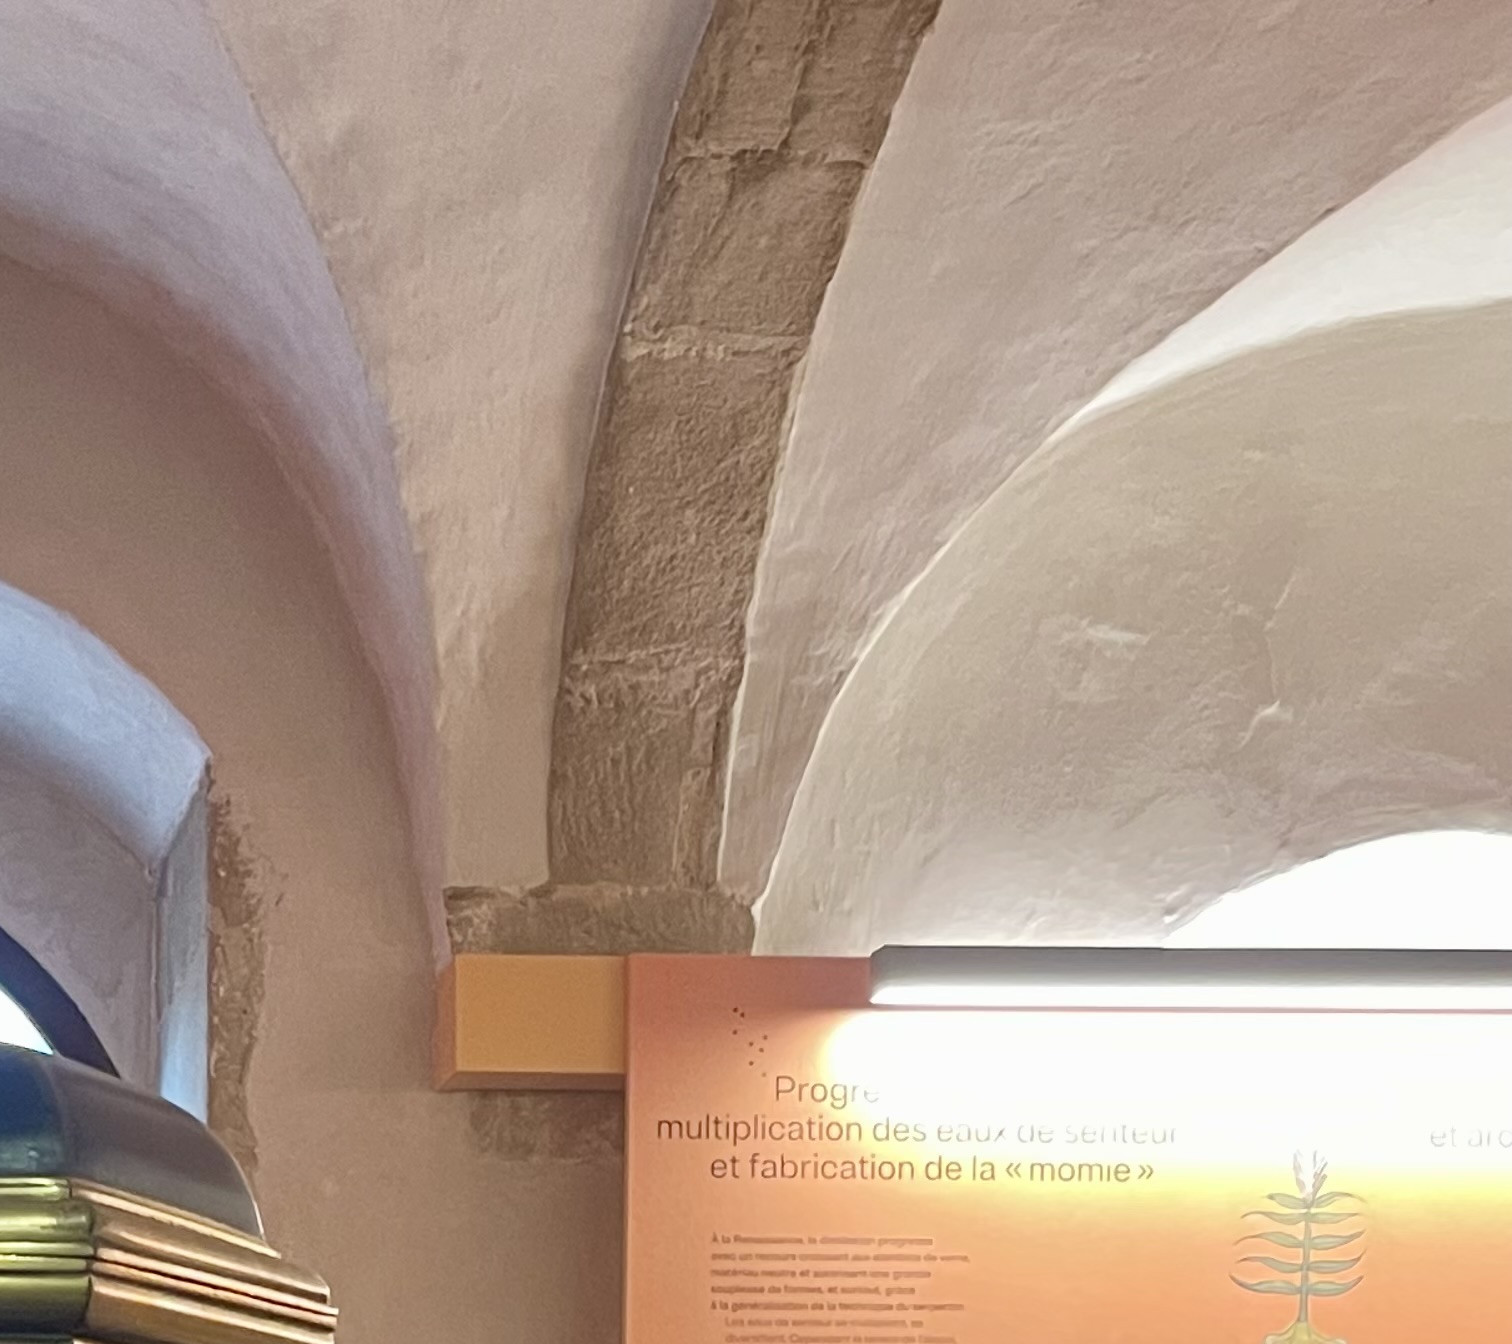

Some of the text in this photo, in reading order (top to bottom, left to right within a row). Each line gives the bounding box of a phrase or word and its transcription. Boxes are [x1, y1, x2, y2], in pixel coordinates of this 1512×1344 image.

[657, 1113, 862, 1146] multiplication
[873, 1116, 926, 1142] des
[937, 1122, 1006, 1142] eaux
[710, 1156, 739, 1179] et
[749, 1153, 914, 1180] fabrication
[925, 1155, 962, 1181] de
[972, 1155, 996, 1181] la
[1029, 1159, 1131, 1182] momie
